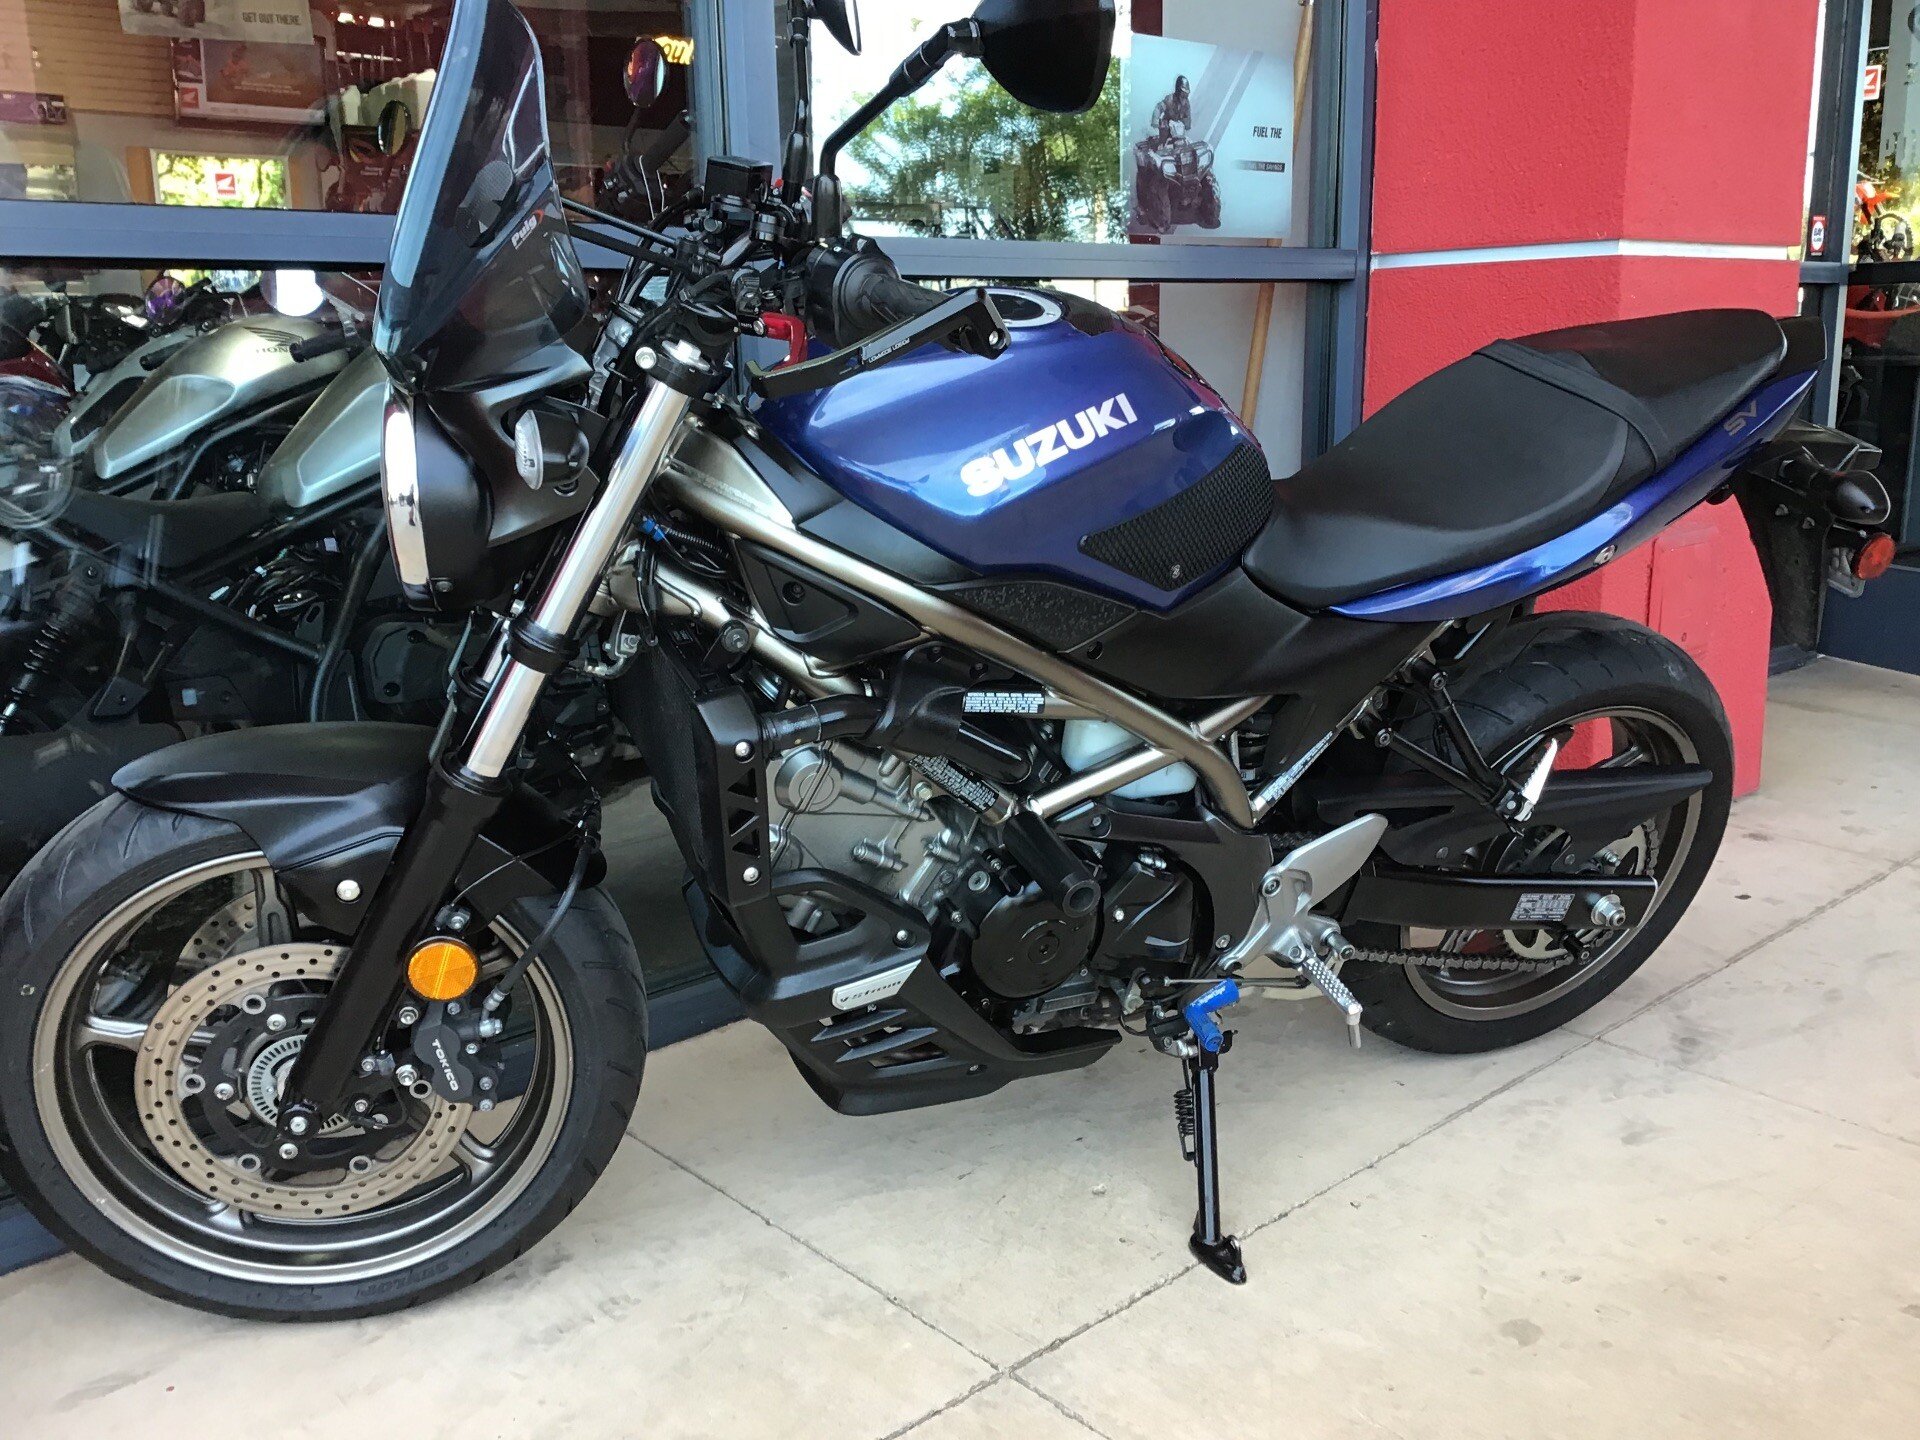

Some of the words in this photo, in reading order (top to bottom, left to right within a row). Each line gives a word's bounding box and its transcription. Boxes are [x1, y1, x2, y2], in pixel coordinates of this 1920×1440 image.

[1252, 125, 1268, 138] FUEL
[1270, 127, 1282, 139] THE
[1723, 400, 1758, 436] SV
[960, 392, 1138, 497] SUZUKI
[431, 1038, 459, 1091] TOKICO
